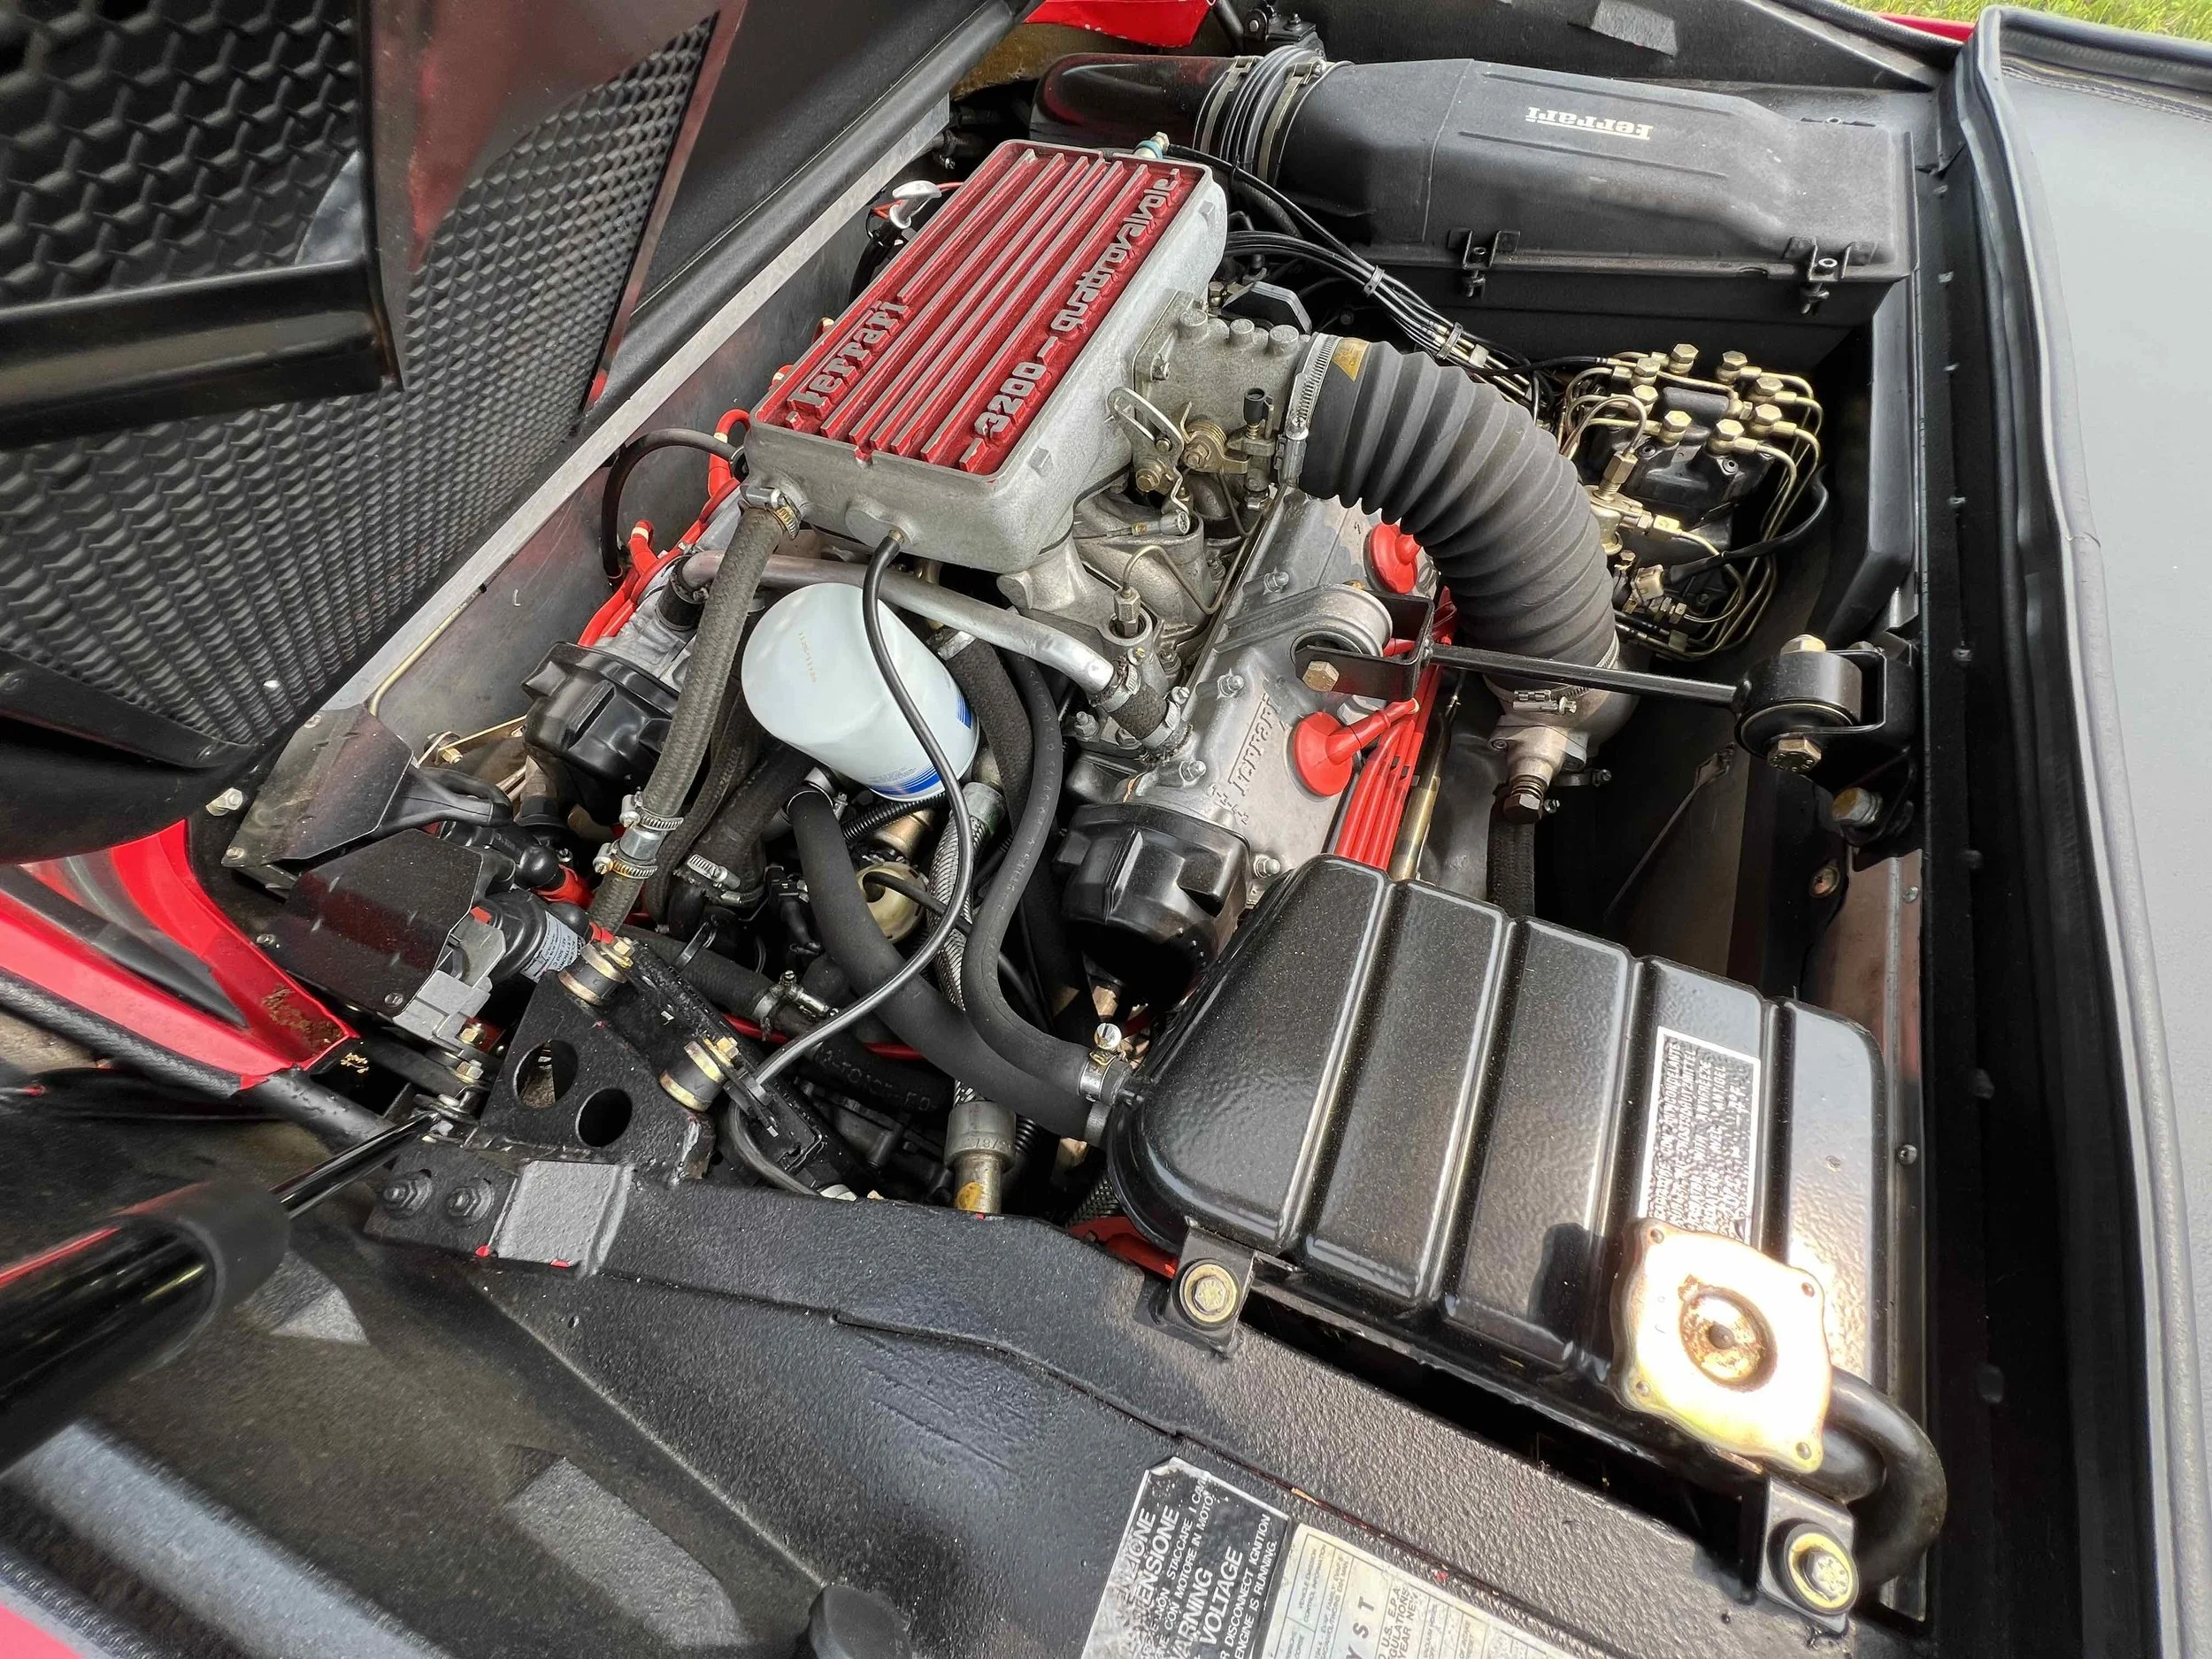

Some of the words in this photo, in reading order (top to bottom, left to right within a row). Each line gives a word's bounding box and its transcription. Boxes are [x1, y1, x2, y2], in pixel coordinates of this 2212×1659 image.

[975, 364, 1047, 435] 3200
[1155, 1586, 1170, 1616] NON
[1167, 1517, 1193, 1579] STACCARE
[1164, 1600, 1179, 1631] CON
[1175, 1548, 1197, 1598] MOTORE
[1191, 1532, 1202, 1546] IN
[1197, 1546, 1243, 1644] VOLTAGE
[1223, 1567, 1254, 1646] DISCONNECT
[1248, 1513, 1271, 1564] IGNITION
[1253, 1539, 1278, 1595] RUNNING.
[1302, 1590, 1315, 1622] CONTROL
[1312, 1542, 1326, 1590] INFORMATION
[1234, 1613, 1255, 1659] ENGINE
[1248, 1597, 1259, 1610] IS
[1381, 1624, 1393, 1647] U.S.
[1399, 1626, 1410, 1658] YEAR
